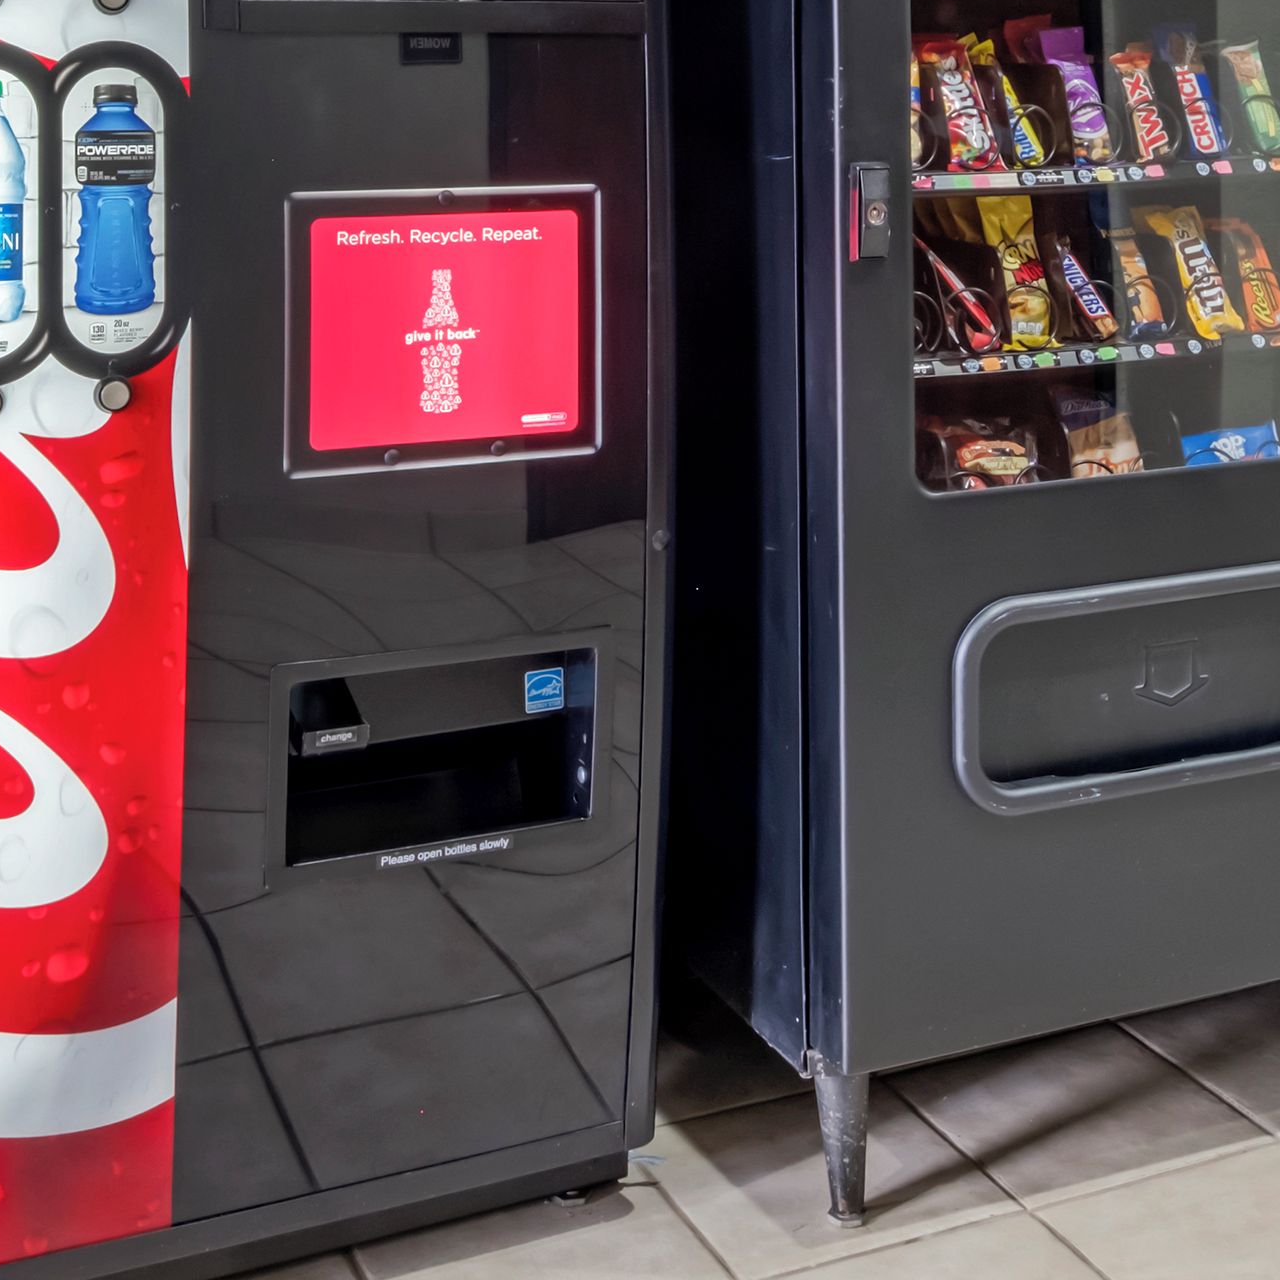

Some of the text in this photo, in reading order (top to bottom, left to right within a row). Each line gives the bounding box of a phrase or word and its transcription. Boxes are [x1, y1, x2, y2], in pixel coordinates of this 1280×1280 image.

[1122, 71, 1169, 160] TWIX
[76, 144, 154, 156] POWERADE
[336, 226, 543, 246] Refresh. Recycle. Repeat.
[998, 238, 1038, 272] CORN
[1061, 254, 1107, 316] SNICKERS
[92, 325, 105, 333] 130
[114, 319, 122, 327] 20
[405, 329, 431, 345] give
[434, 329, 445, 342] it
[320, 731, 353, 744] change
[381, 837, 509, 867] Please open bottles slowly
